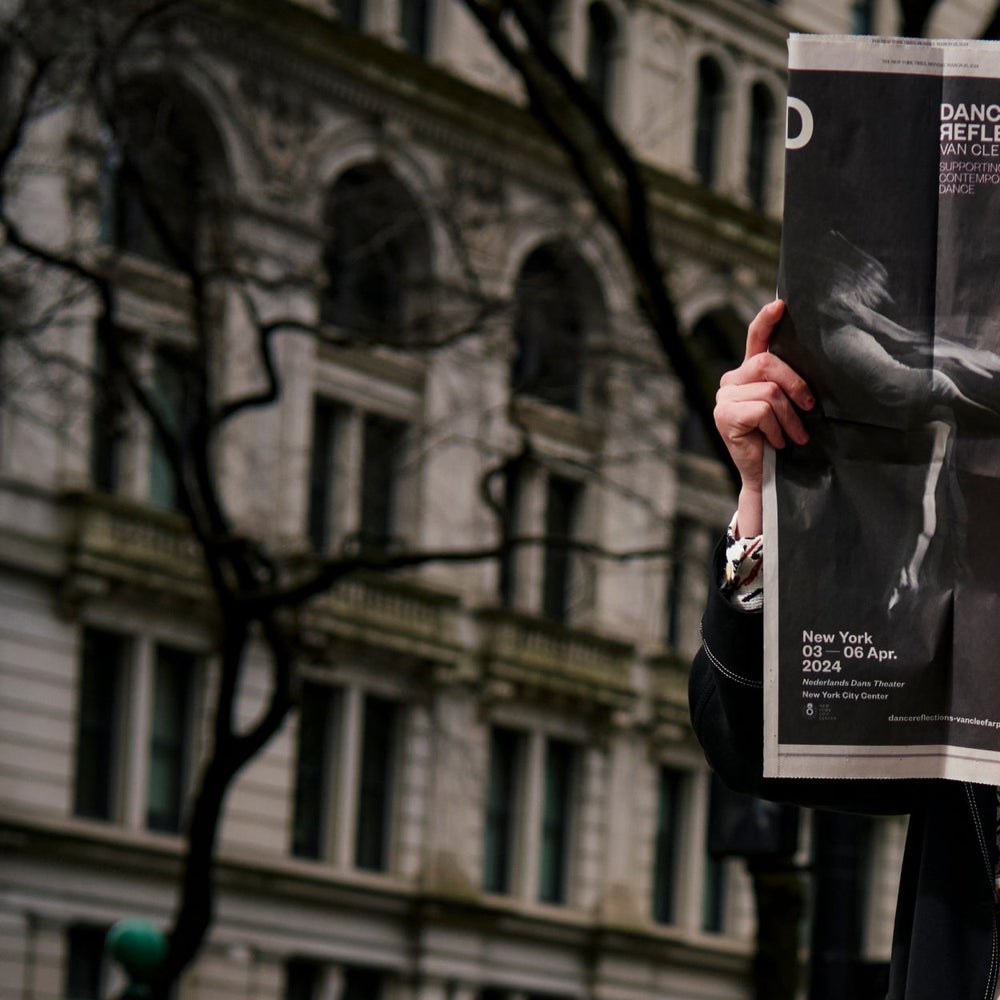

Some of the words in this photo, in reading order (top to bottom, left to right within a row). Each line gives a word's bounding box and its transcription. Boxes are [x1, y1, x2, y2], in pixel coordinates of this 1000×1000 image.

[940, 143, 967, 156] VAN
[939, 184, 975, 195] DANCE
[802, 630, 836, 643] New
[839, 630, 873, 645] York
[802, 645, 823, 658] 03
[843, 645, 864, 659] 06
[866, 646, 898, 662] Apr.
[802, 660, 842, 673] 2024
[802, 678, 850, 687] Nederlands
[850, 679, 872, 688] Dans
[873, 679, 906, 688] Theater
[802, 691, 820, 699] New
[821, 691, 841, 699] York
[842, 691, 860, 700] City
[861, 691, 889, 700] Center
